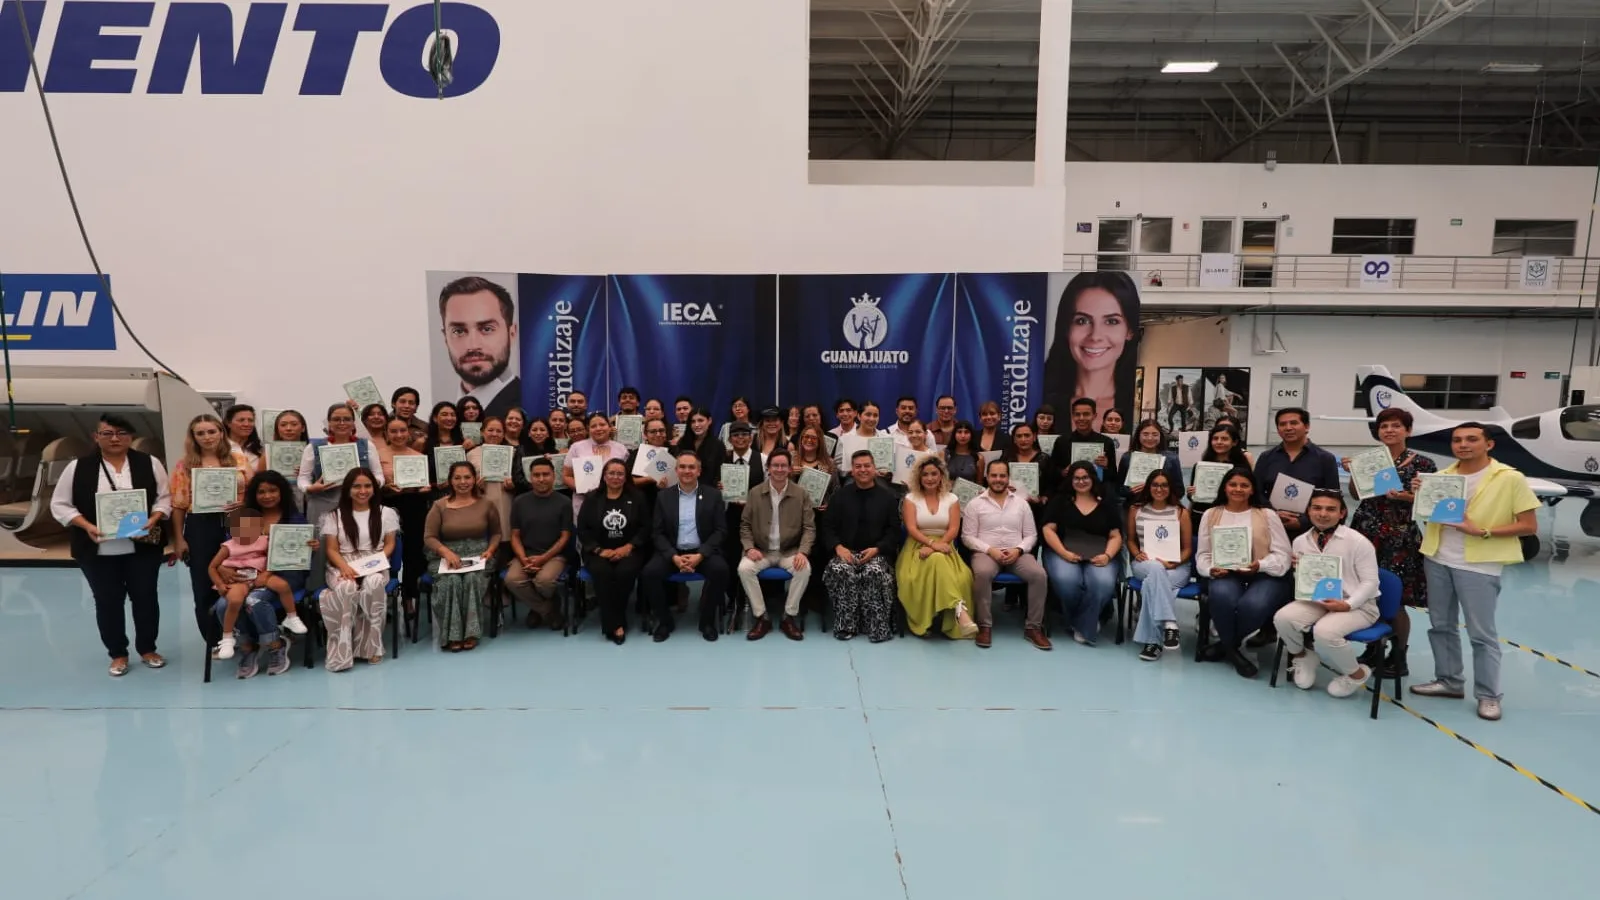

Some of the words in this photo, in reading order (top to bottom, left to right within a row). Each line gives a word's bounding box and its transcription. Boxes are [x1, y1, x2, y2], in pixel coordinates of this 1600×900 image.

[1262, 201, 1268, 209] 9
[663, 302, 717, 321] IECA
[548, 301, 579, 411] endizaje
[821, 350, 909, 363] GUANAJUATO
[1277, 389, 1298, 397] CNC
